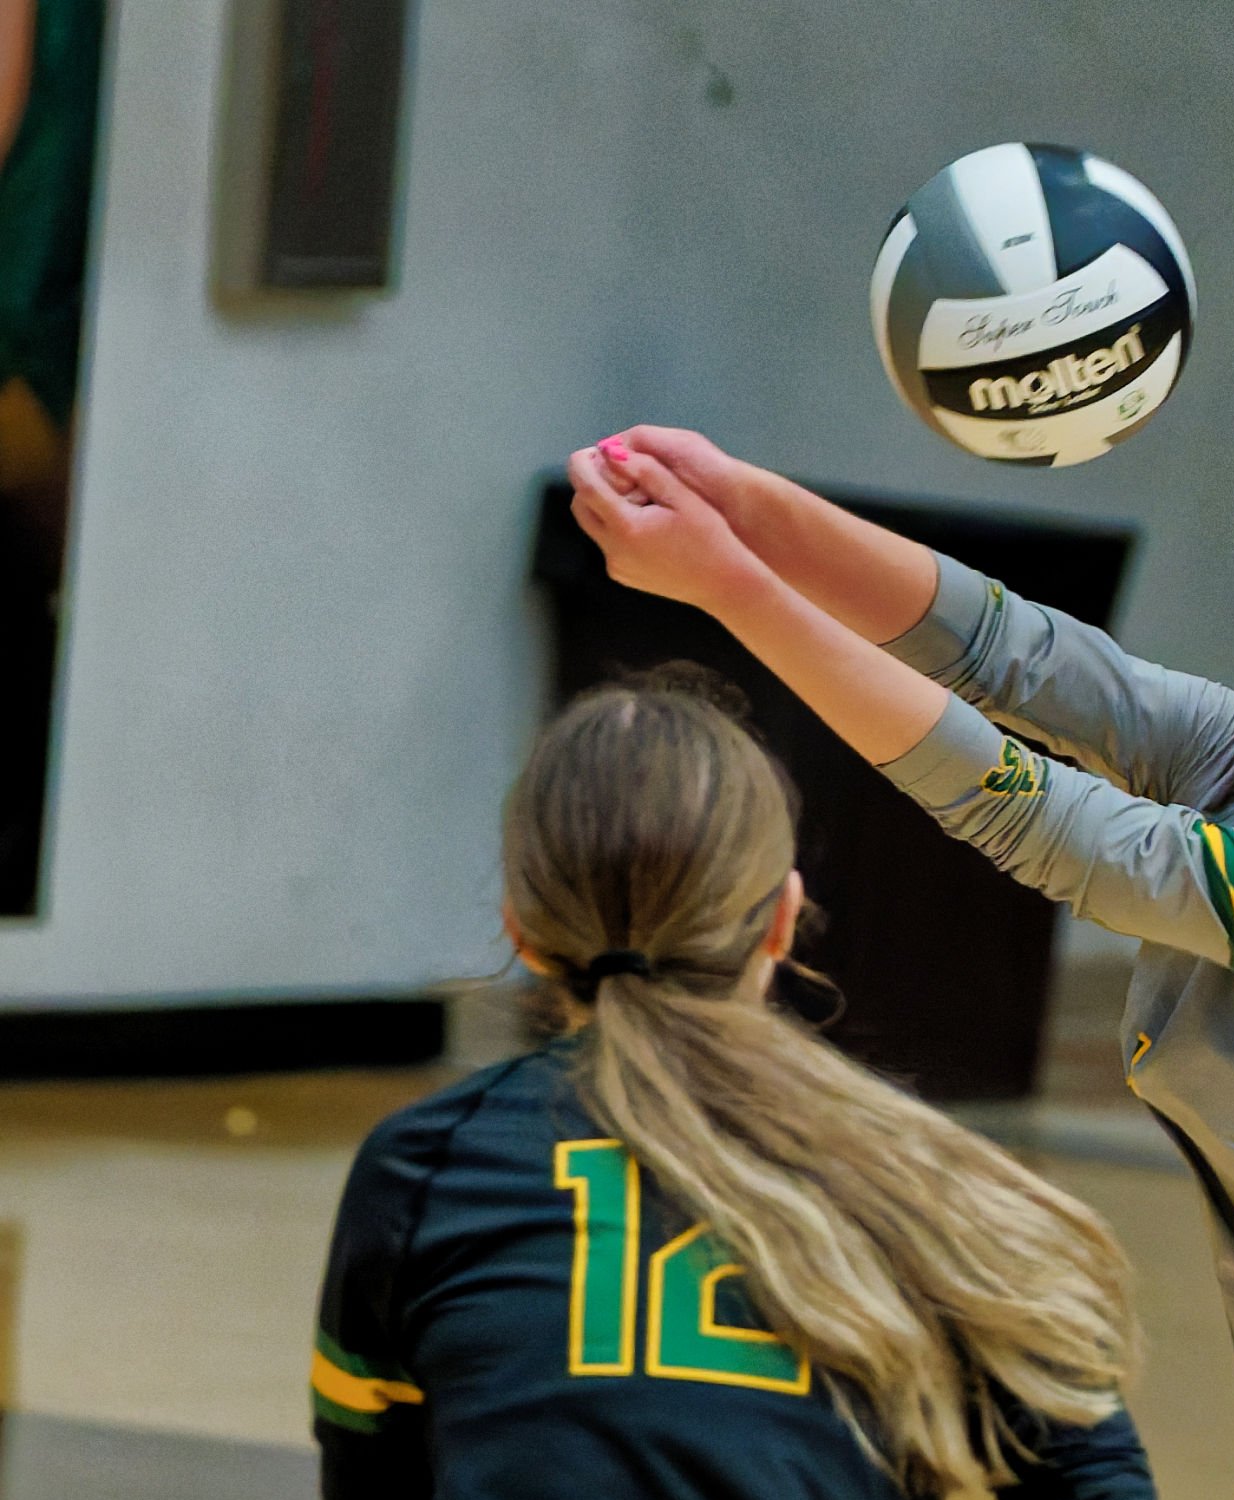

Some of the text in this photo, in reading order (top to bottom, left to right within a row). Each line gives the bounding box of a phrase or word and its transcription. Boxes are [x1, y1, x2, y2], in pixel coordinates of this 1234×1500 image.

[958, 278, 1119, 352] Super Touch
[968, 331, 1146, 412] molten
[554, 1137, 812, 1396] 12
